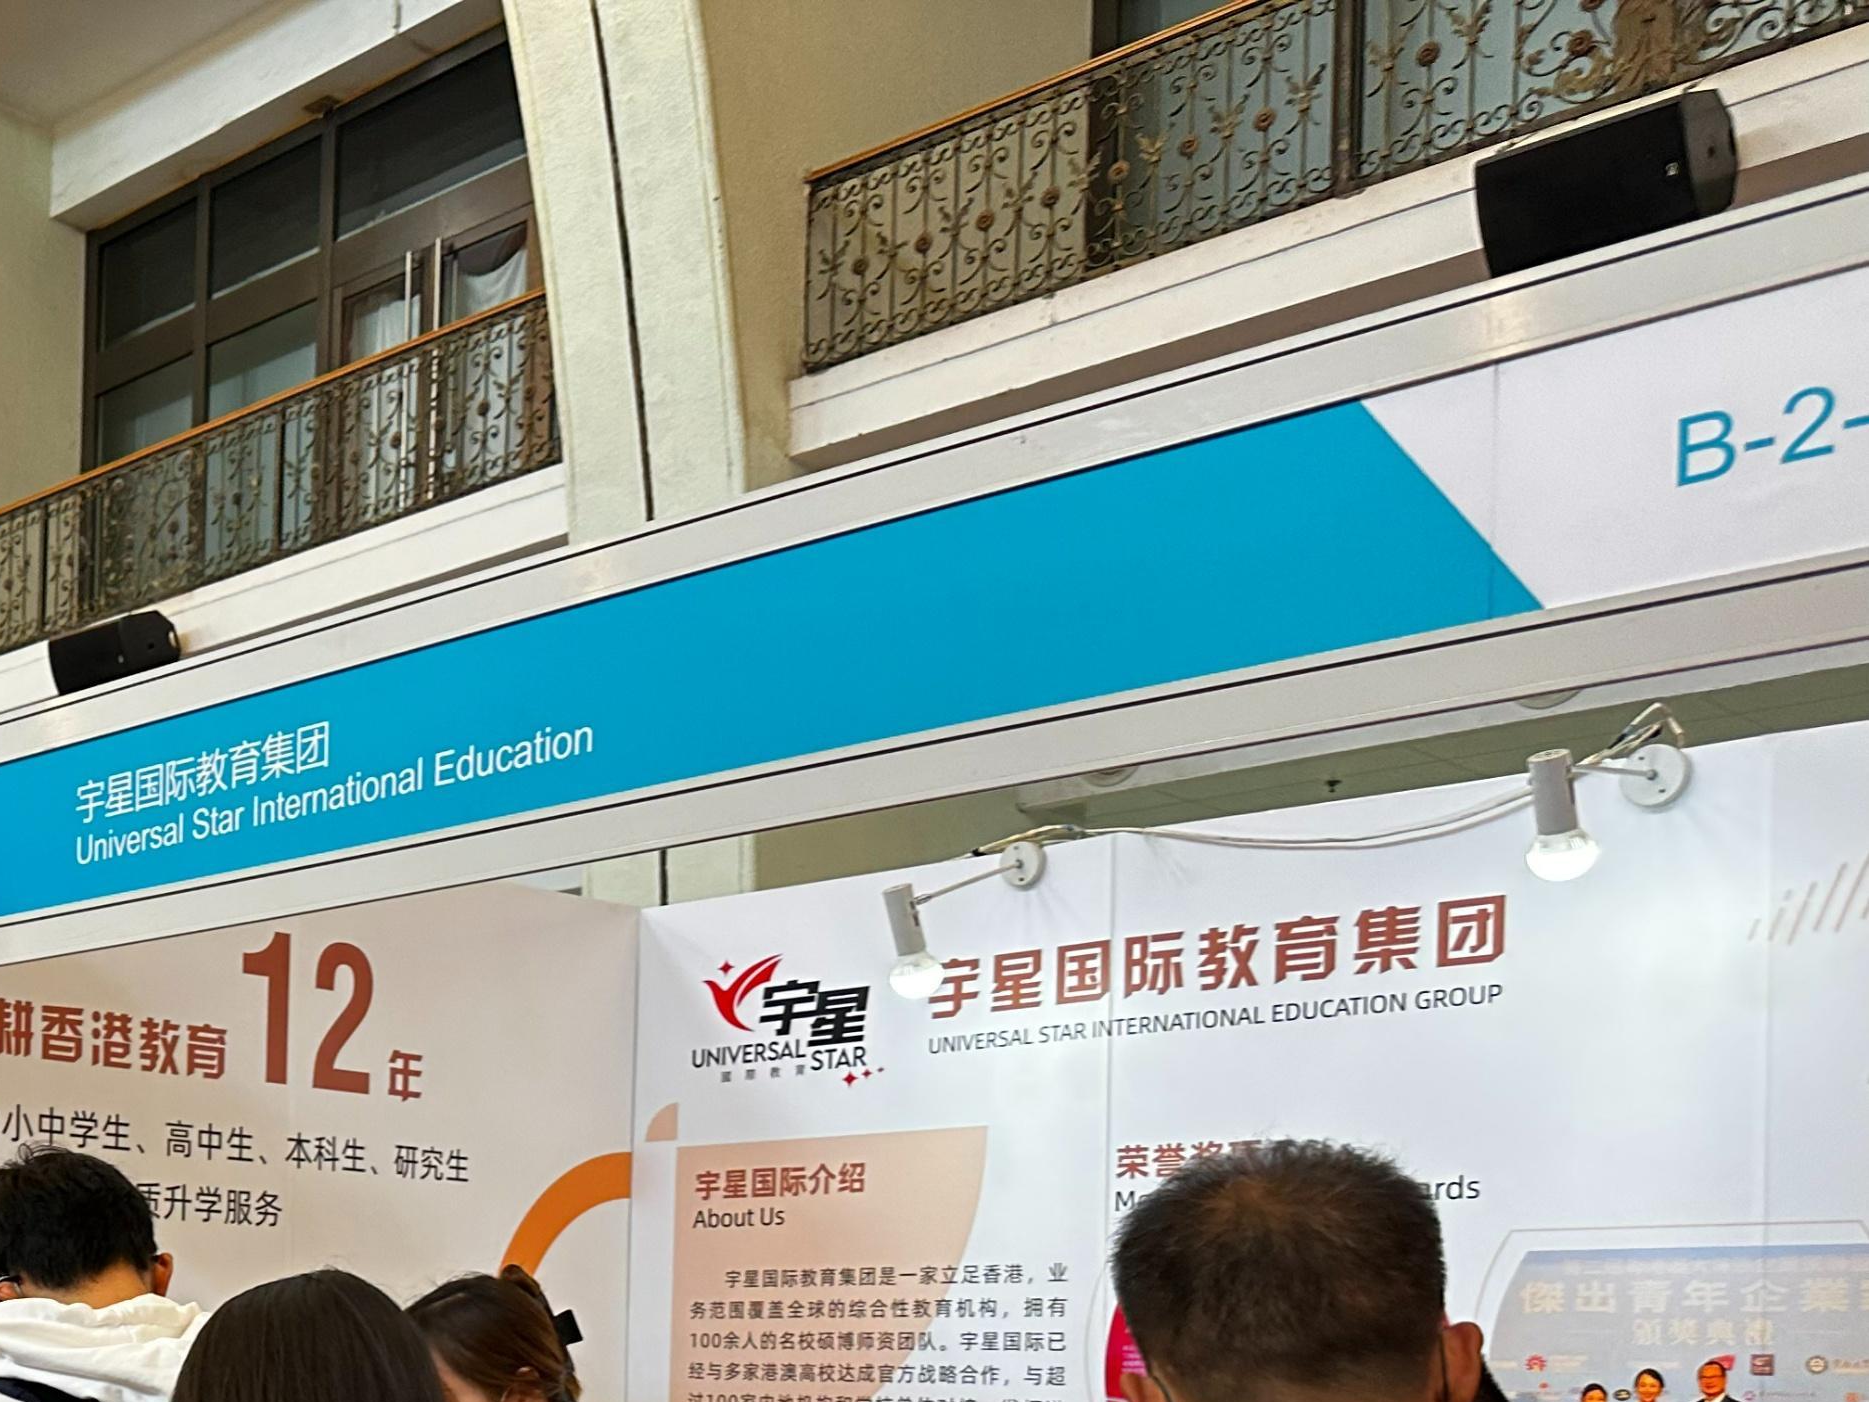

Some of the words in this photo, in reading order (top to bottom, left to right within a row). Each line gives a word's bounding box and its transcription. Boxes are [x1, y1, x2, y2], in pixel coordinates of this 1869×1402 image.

[75, 721, 330, 824] 宇星国际教育集团
[75, 819, 185, 865] Universal
[192, 806, 245, 839] Star
[252, 758, 424, 828] International
[433, 722, 594, 787] Education
[929, 894, 1506, 1020] 宇星国际教育集团
[760, 980, 870, 1047] 宇星
[928, 1028, 1031, 1054] UNIVERSAL
[1038, 1021, 1086, 1042] STAR
[1091, 1006, 1265, 1038] INTERNATIONAL
[1272, 994, 1407, 1022] EDUCATION
[1415, 985, 1503, 1010] GROUP
[692, 1039, 806, 1068] UNIVERSAL
[810, 1046, 866, 1070] STAR
[695, 1162, 866, 1201] 宇星国际介绍
[692, 1209, 754, 1229] About
[760, 1207, 785, 1226] Us
